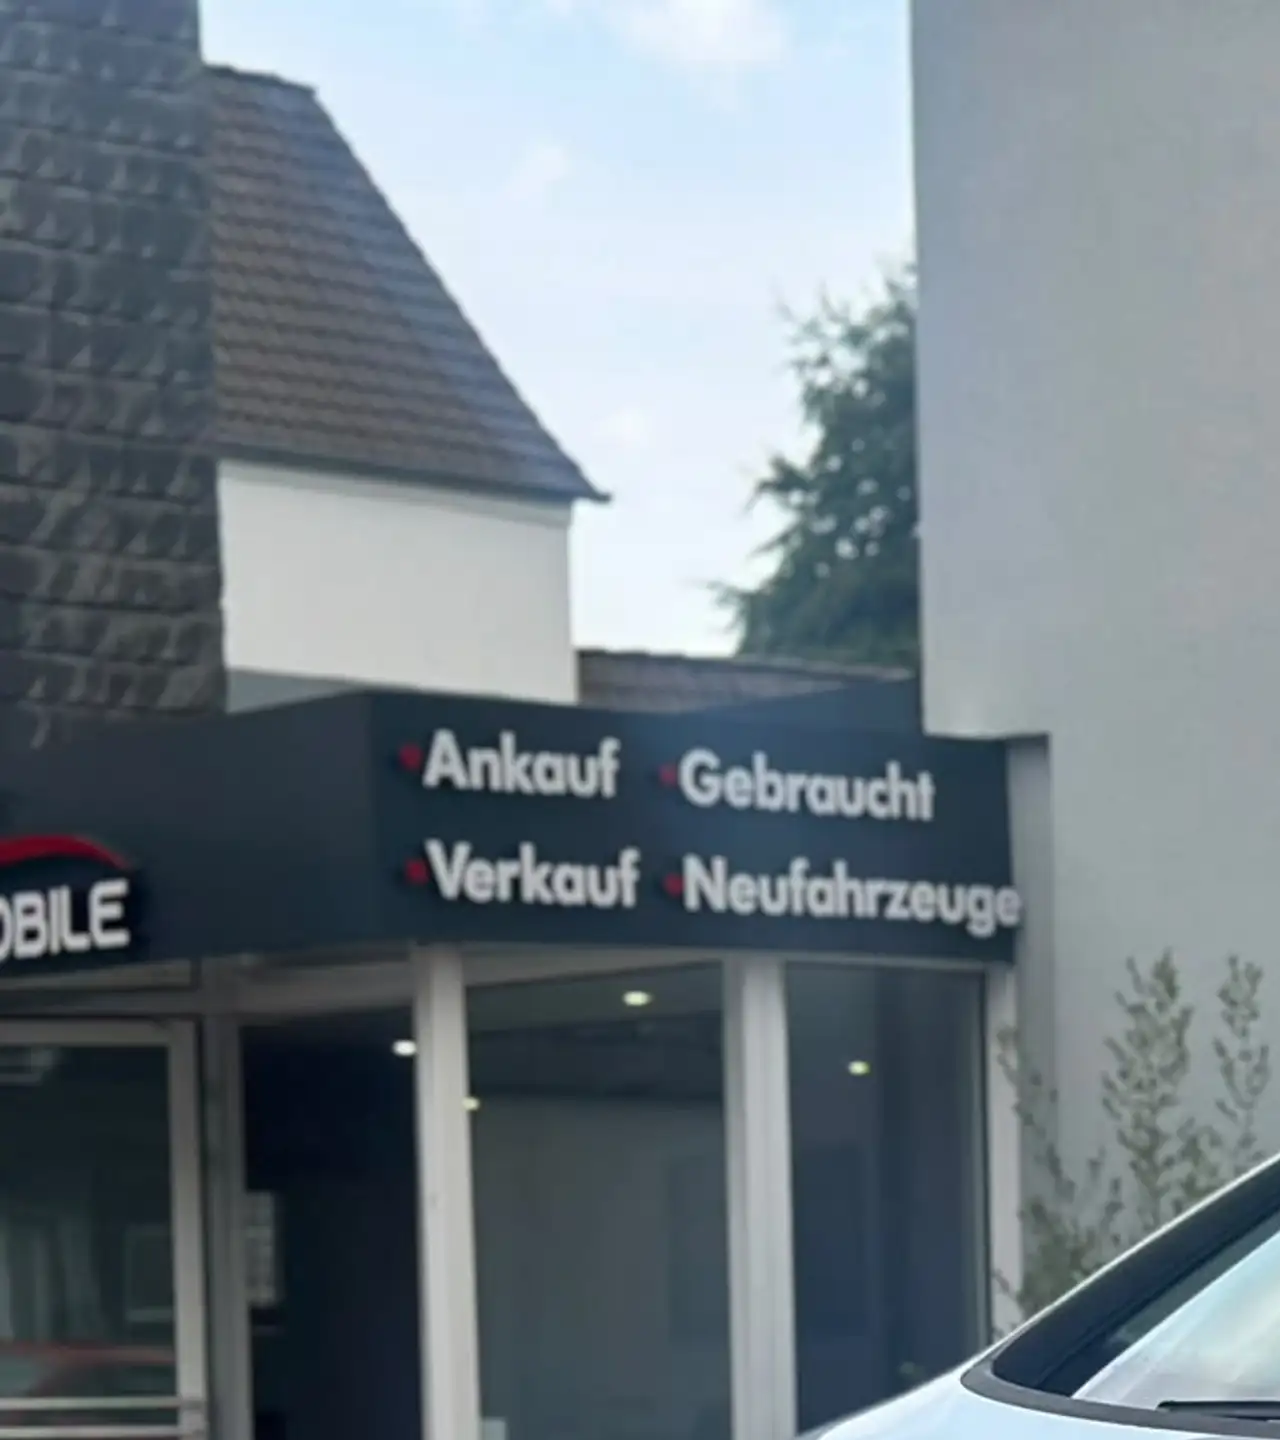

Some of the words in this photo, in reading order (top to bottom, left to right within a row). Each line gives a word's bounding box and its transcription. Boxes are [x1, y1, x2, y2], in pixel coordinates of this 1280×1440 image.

[423, 728, 621, 798] Ankauf
[679, 748, 935, 822] Gebraucht
[425, 838, 640, 908] Verkauf
[682, 853, 1021, 937] Neufahrzeuge
[0, 877, 130, 962] BILE
